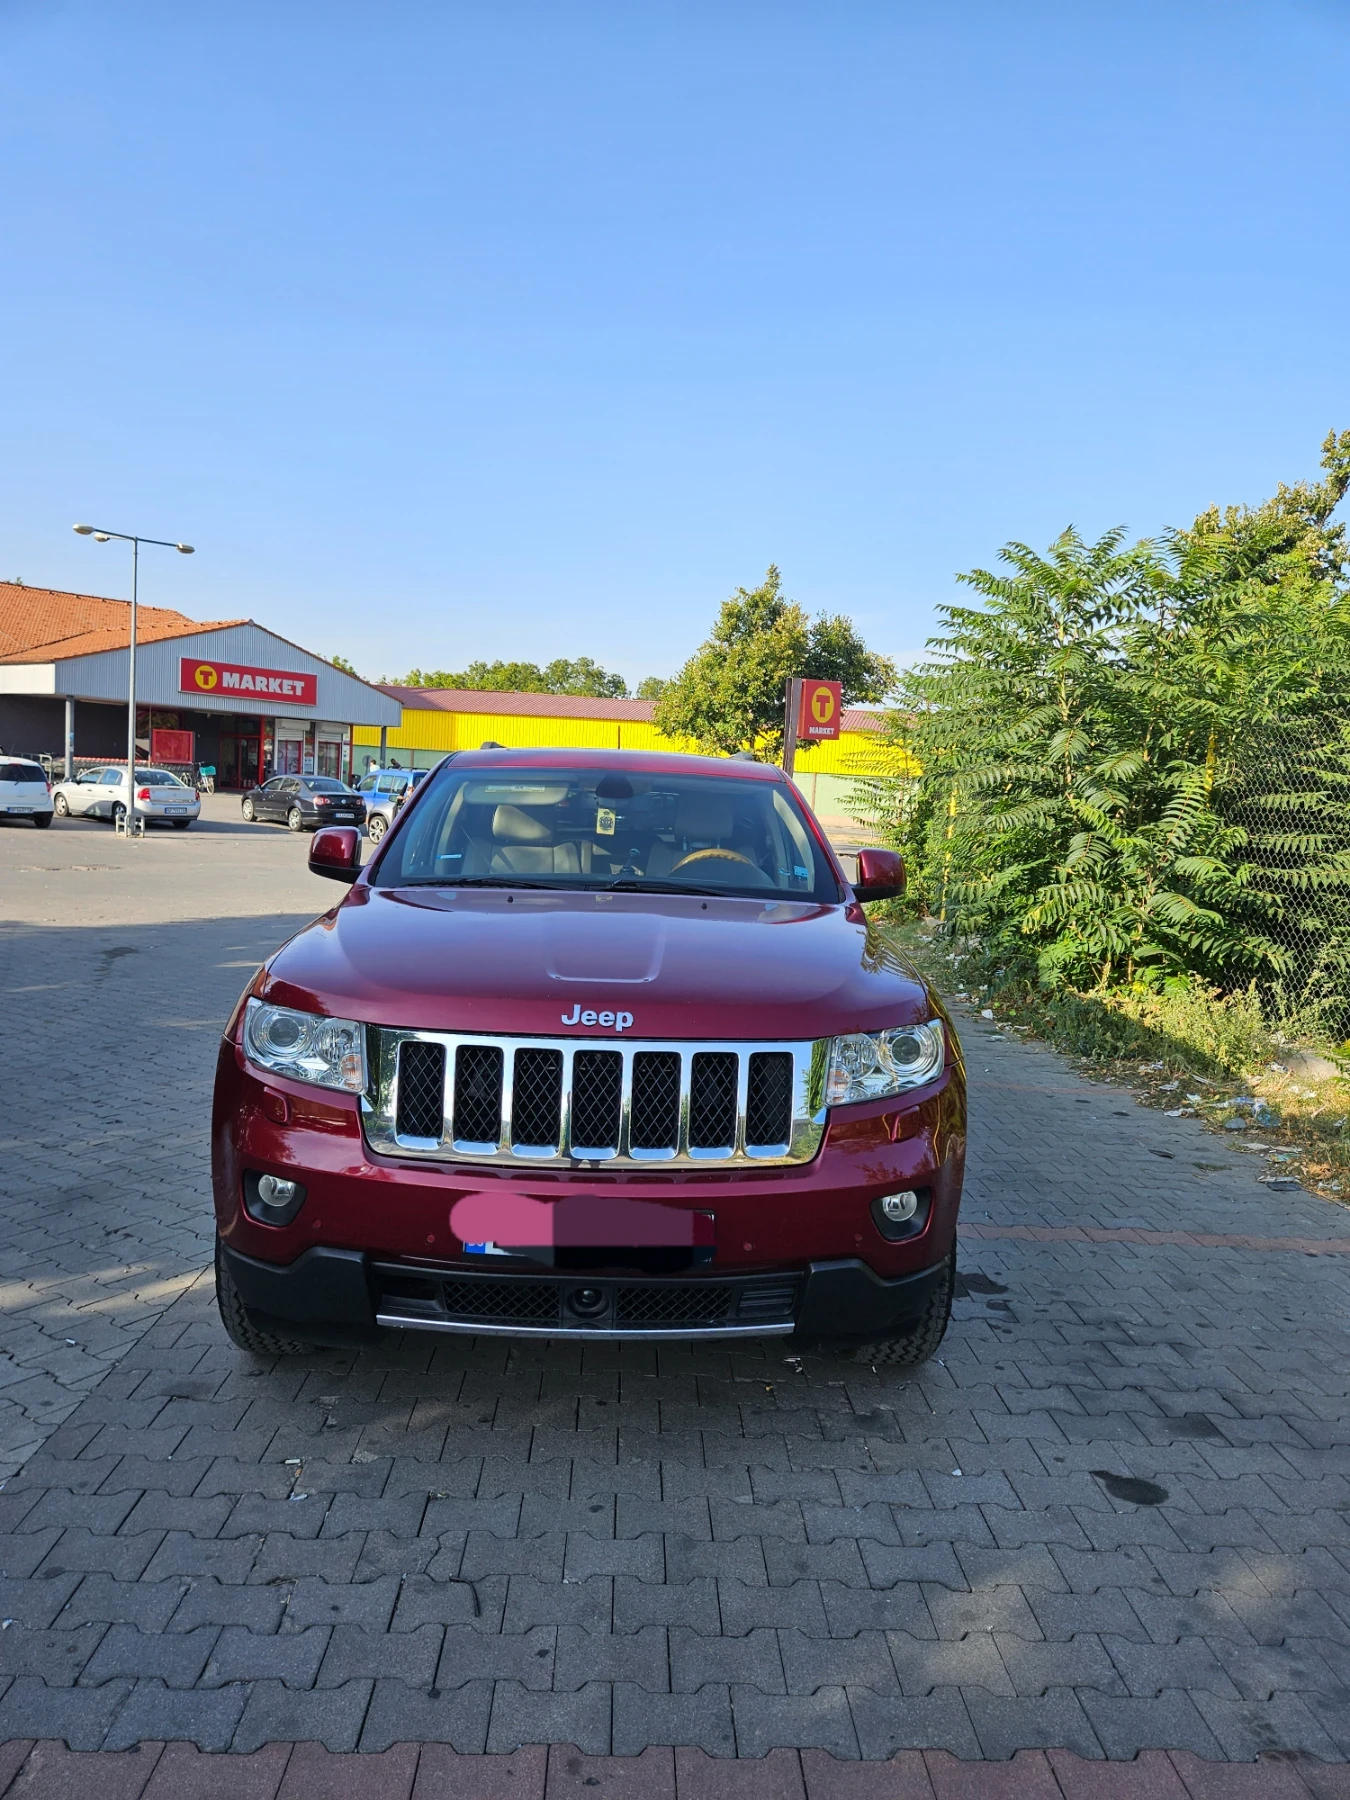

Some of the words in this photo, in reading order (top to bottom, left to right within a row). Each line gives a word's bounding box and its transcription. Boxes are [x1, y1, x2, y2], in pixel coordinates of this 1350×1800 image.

[199, 669, 213, 686] T
[222, 671, 305, 696] MARKET
[815, 694, 831, 718] T
[809, 726, 835, 735] MARKET
[561, 1004, 634, 1032] Jeep
